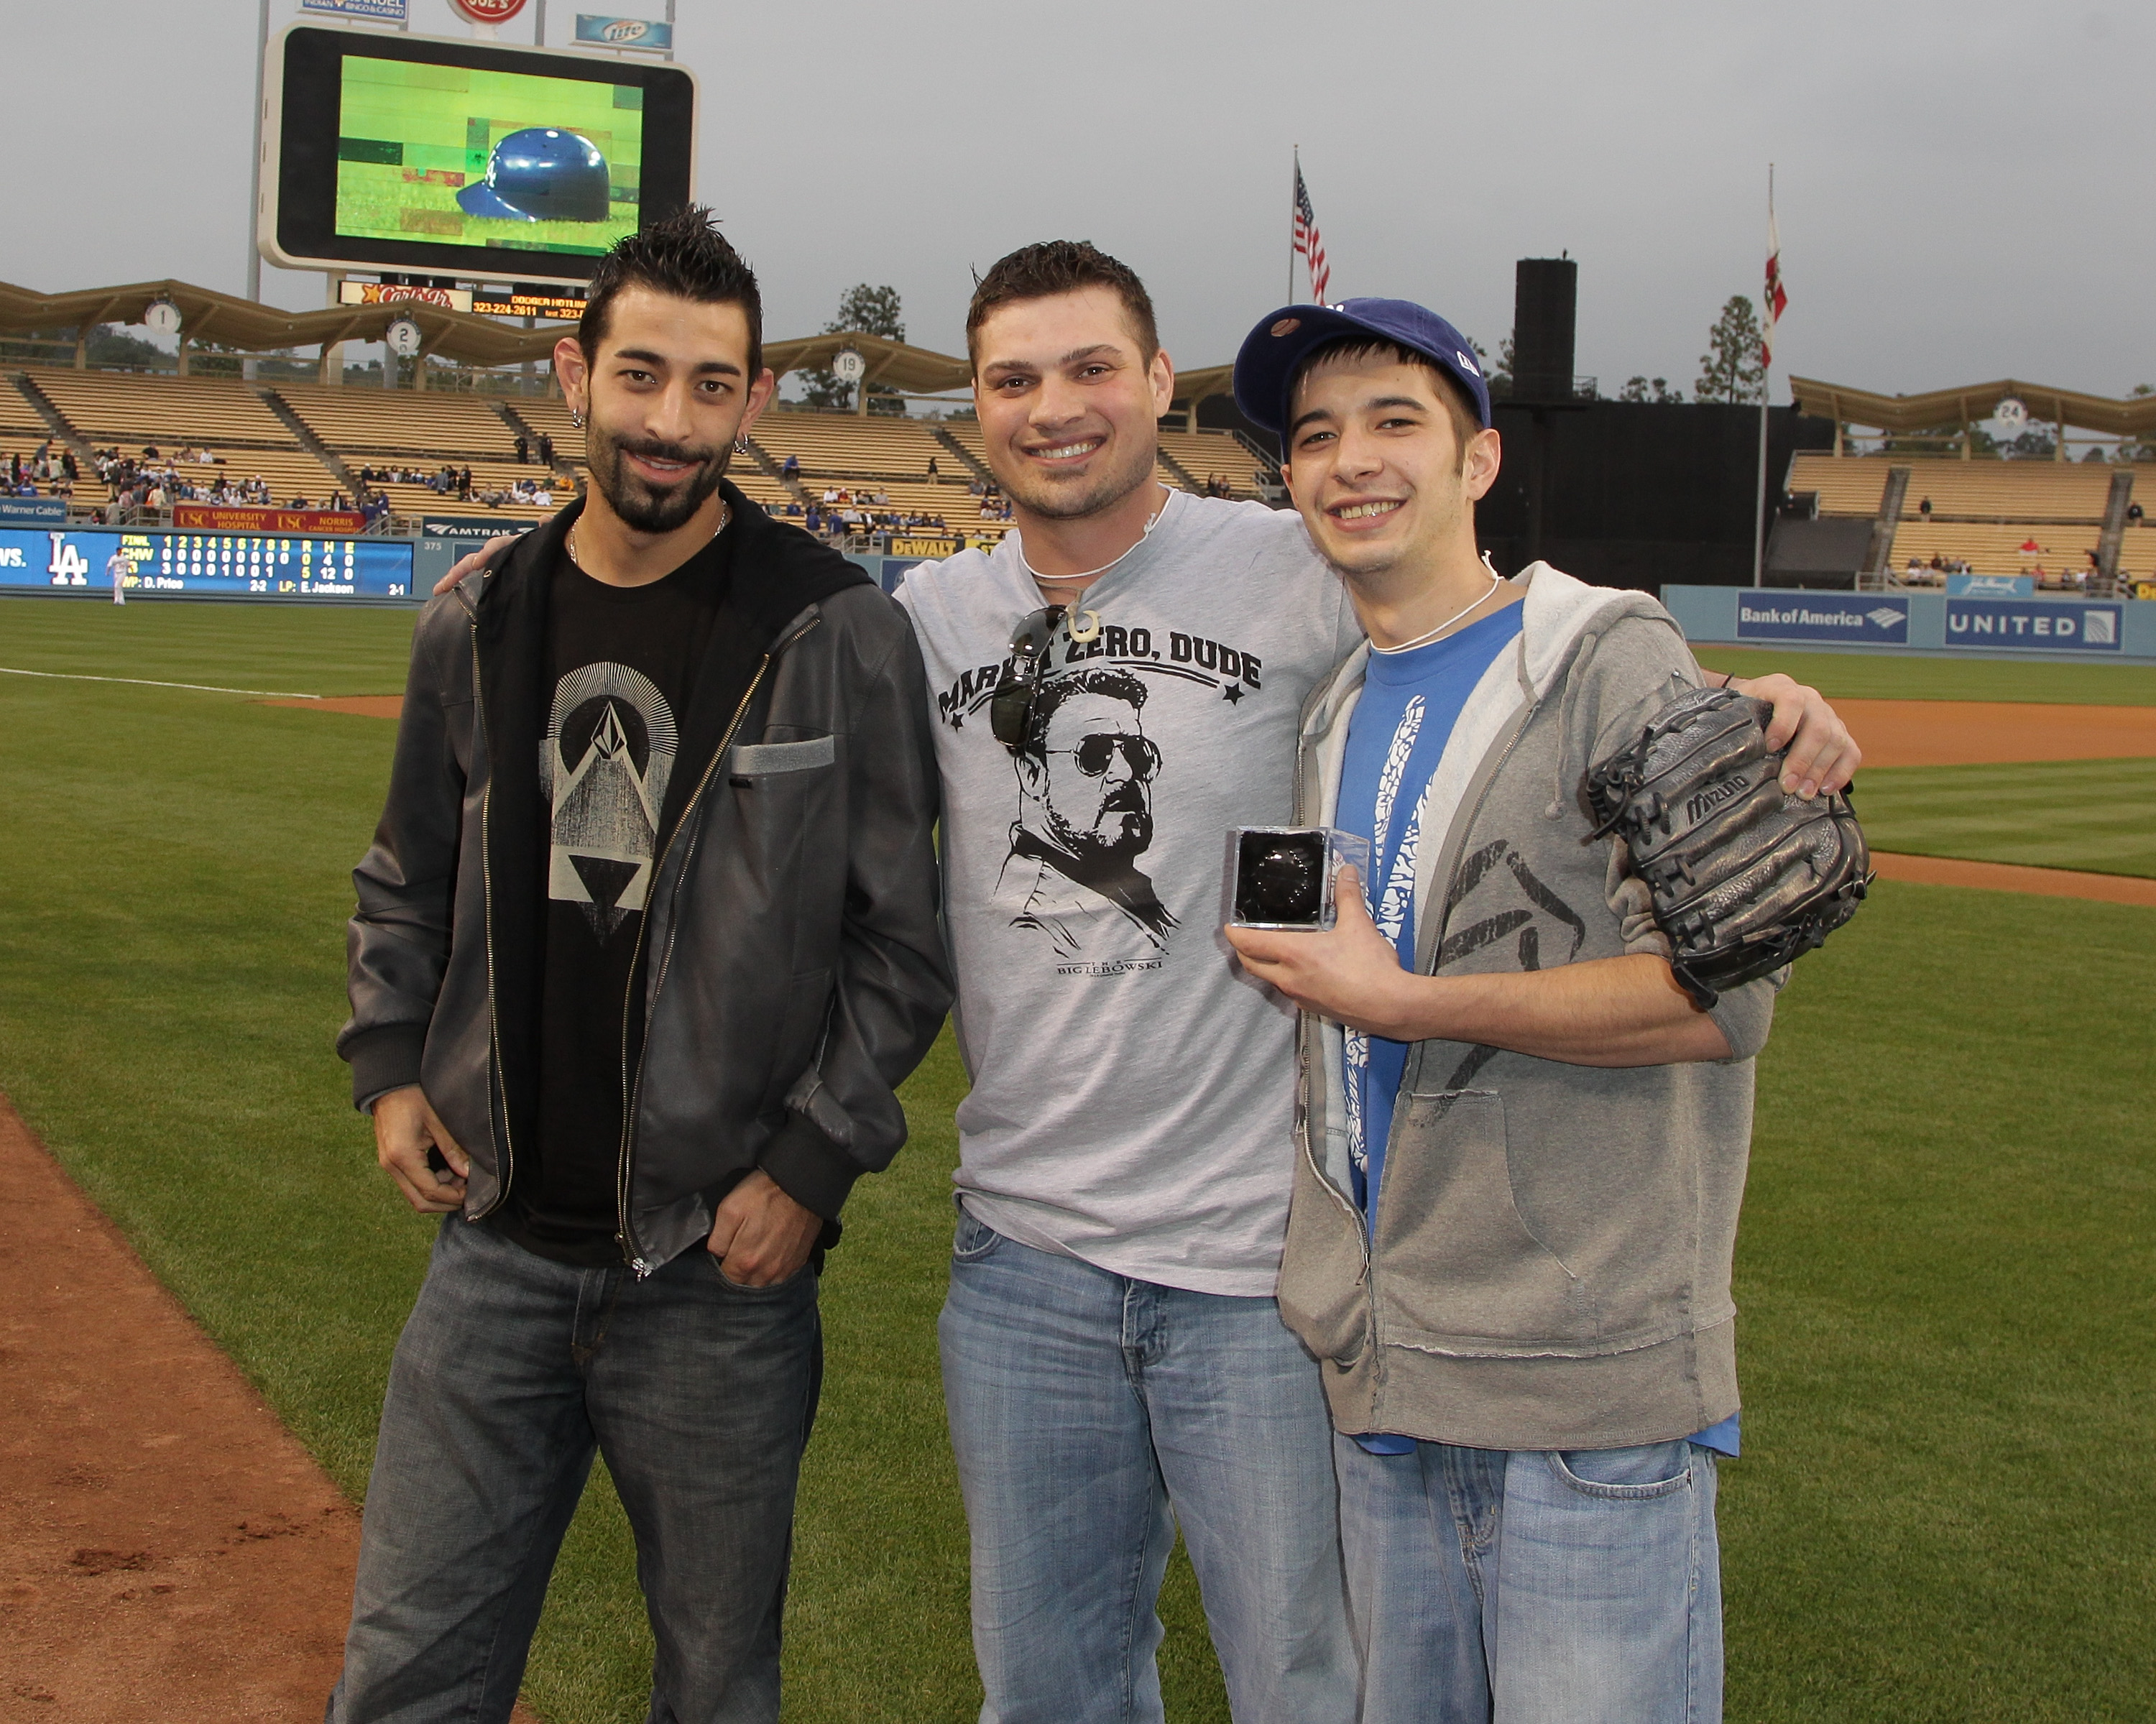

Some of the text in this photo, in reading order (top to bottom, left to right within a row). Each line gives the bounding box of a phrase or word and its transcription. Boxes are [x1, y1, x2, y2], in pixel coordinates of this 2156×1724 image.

[609, 26, 641, 40] Lite
[379, 287, 451, 307] Carl's Jr.
[511, 295, 550, 306] DODGER
[473, 302, 537, 316] 323-224-2611
[400, 328, 408, 341] 2
[844, 358, 855, 371] 19
[2001, 405, 2020, 418] 24
[2, 504, 63, 516] Warner Cable
[212, 511, 267, 522] UNIVERSITY
[179, 510, 209, 527] USC
[217, 520, 261, 530] HOSPITAL
[277, 513, 307, 532] USC
[319, 517, 354, 526] NORRIS
[448, 527, 512, 536] AMTRAK
[121, 535, 354, 554] FINAL 1 2 3 4 5 6 7 8 9 R H E
[424, 541, 442, 550] 375
[48, 532, 88, 586] LA
[121, 548, 354, 567] CHW 0 0 0 0 0 0 0 0 0 0 4 0
[162, 562, 171, 574] 3
[176, 562, 186, 575] 0
[191, 563, 201, 576] 0
[206, 563, 216, 576] 0
[222, 564, 230, 576] 1
[236, 564, 245, 577] 0
[251, 565, 260, 577] 0
[265, 565, 274, 578] 1
[302, 566, 310, 578] 5
[321, 567, 336, 580] 12
[344, 568, 354, 580] 0
[144, 577, 155, 589] D.
[157, 577, 184, 589] Price
[250, 580, 267, 592] 2-2
[278, 580, 296, 593] LP:
[300, 581, 310, 593] E.
[312, 581, 354, 594] Jackson
[389, 584, 405, 596] 2-1
[1740, 607, 1864, 627] Bank of America
[1949, 613, 2077, 637] UNITED
[1063, 625, 1161, 663] ZERO,
[1169, 631, 1262, 690] DUDE
[1086, 961, 1163, 974] LEBOWSKI
